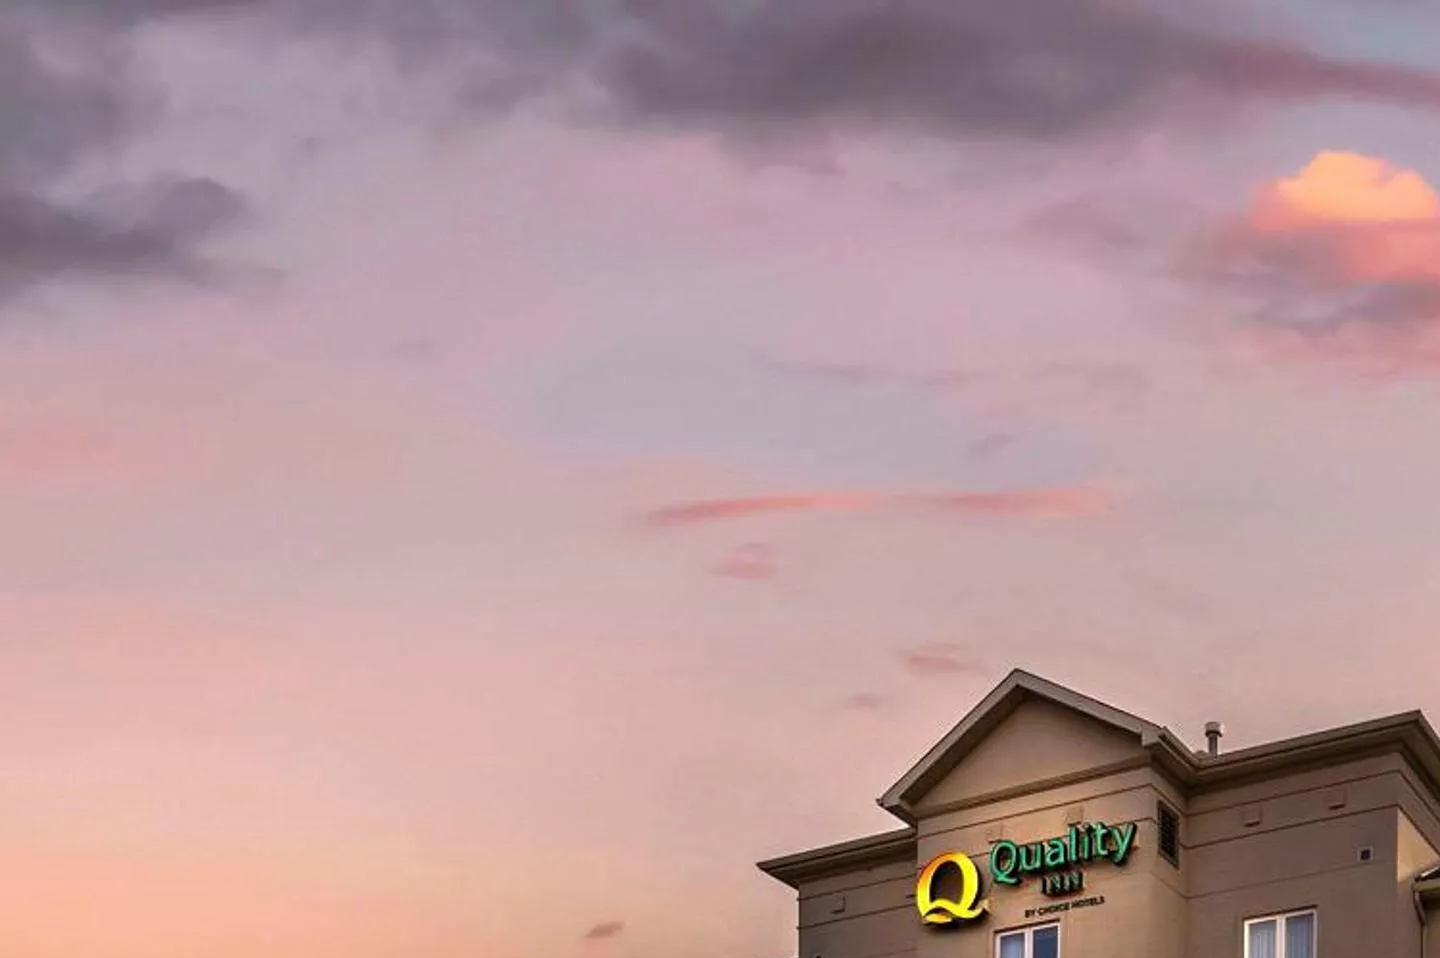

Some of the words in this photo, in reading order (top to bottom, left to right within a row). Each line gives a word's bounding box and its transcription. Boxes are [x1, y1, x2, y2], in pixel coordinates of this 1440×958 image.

[990, 821, 1137, 885] Quality
[917, 851, 988, 923] Q
[1042, 872, 1085, 896] INN
[1025, 906, 1036, 918] BY
[1038, 902, 1069, 917] CHOICE
[1072, 895, 1105, 911] HOTELS
